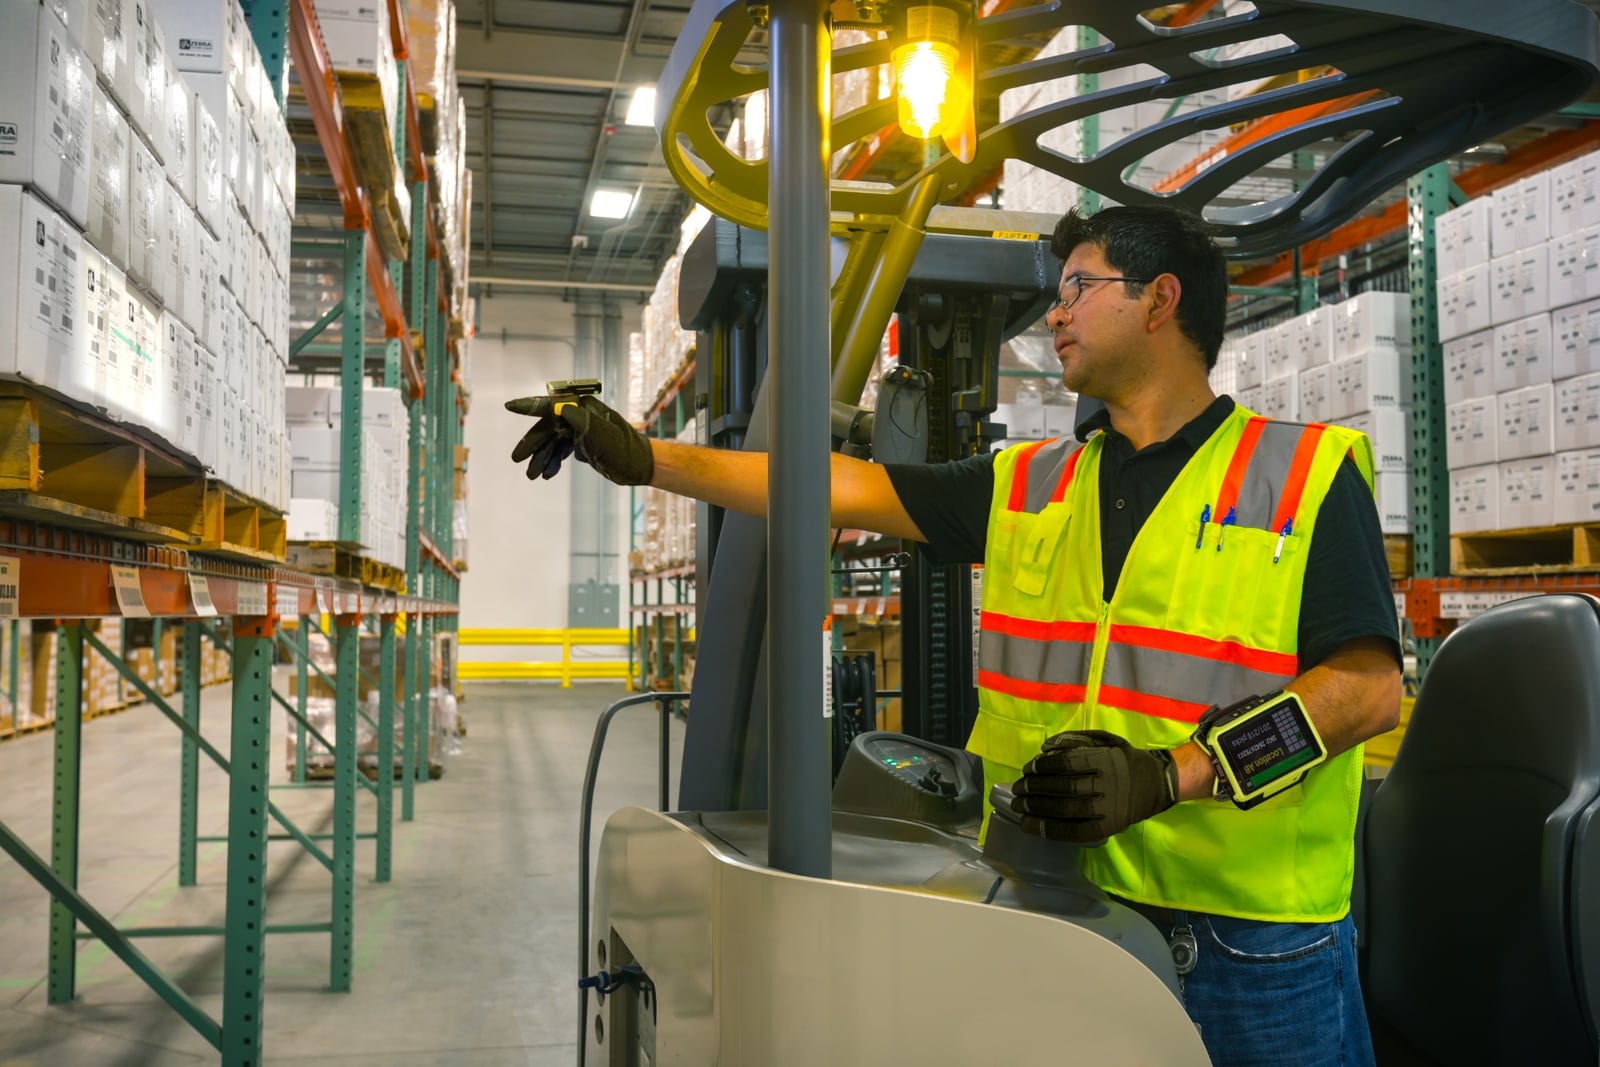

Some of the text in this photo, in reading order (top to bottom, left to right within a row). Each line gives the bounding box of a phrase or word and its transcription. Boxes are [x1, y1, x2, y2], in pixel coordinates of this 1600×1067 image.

[1231, 733, 1247, 747] picks
[1243, 747, 1285, 774] Location AB
